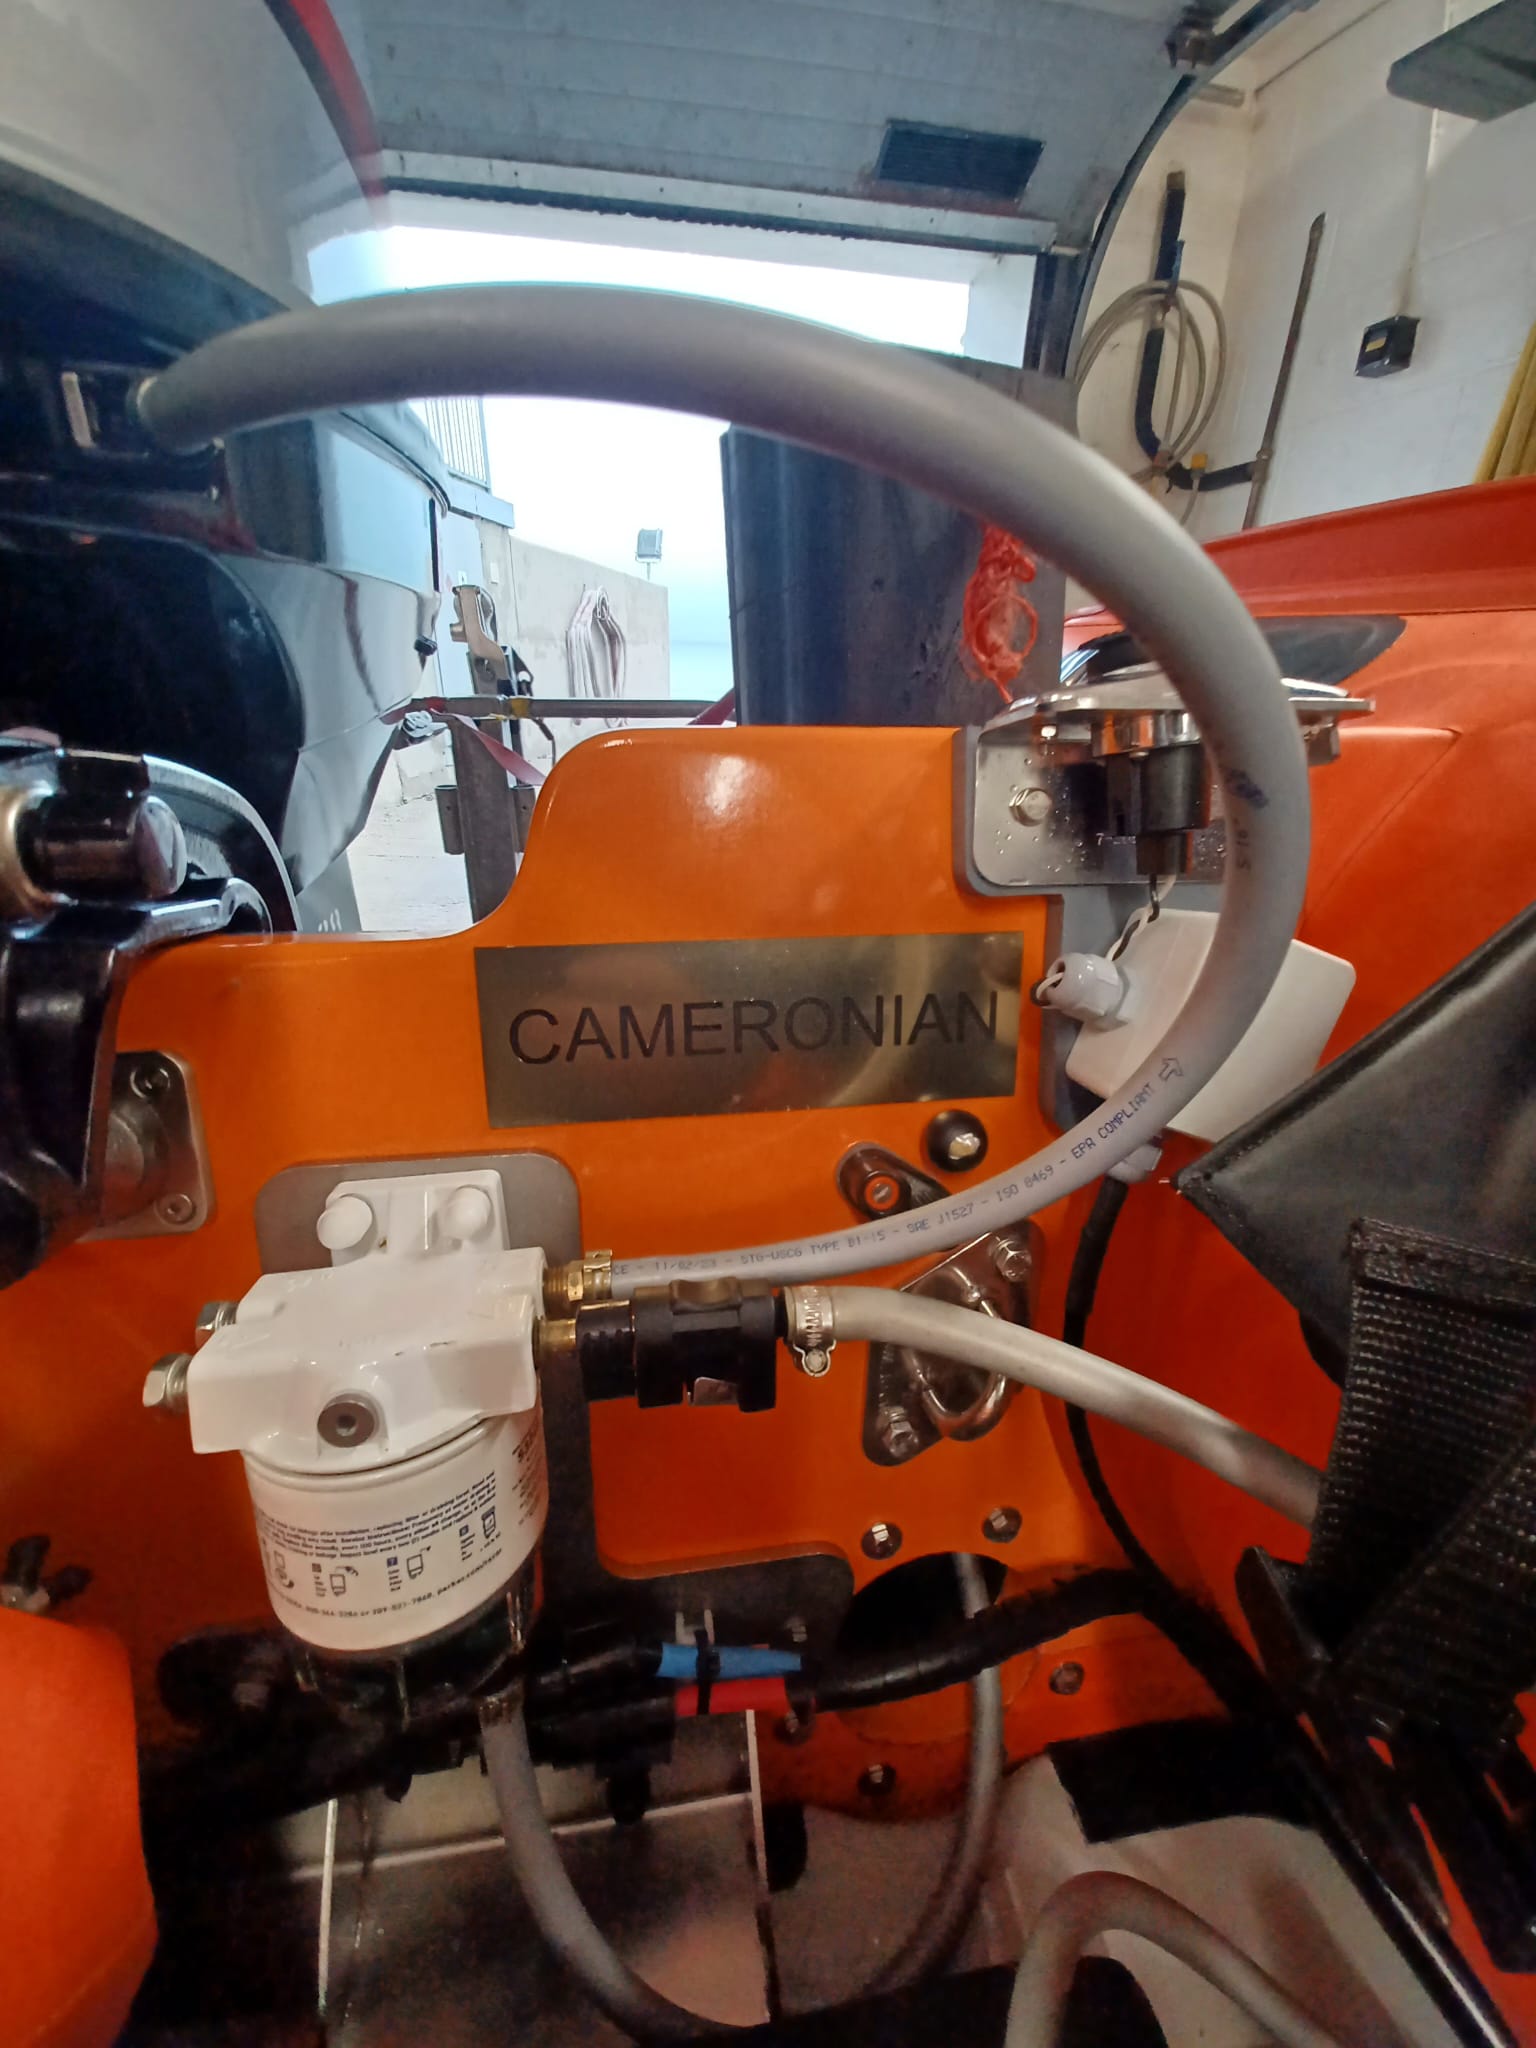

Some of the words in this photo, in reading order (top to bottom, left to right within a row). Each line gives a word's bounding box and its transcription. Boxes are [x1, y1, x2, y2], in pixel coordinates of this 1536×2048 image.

[508, 990, 998, 1065] CAMERONIAN
[810, 1240, 840, 1255] TYPE
[937, 1202, 975, 1225] J1527
[996, 1184, 1020, 1202] ISO
[1098, 1081, 1157, 1140] COMPLIANT
